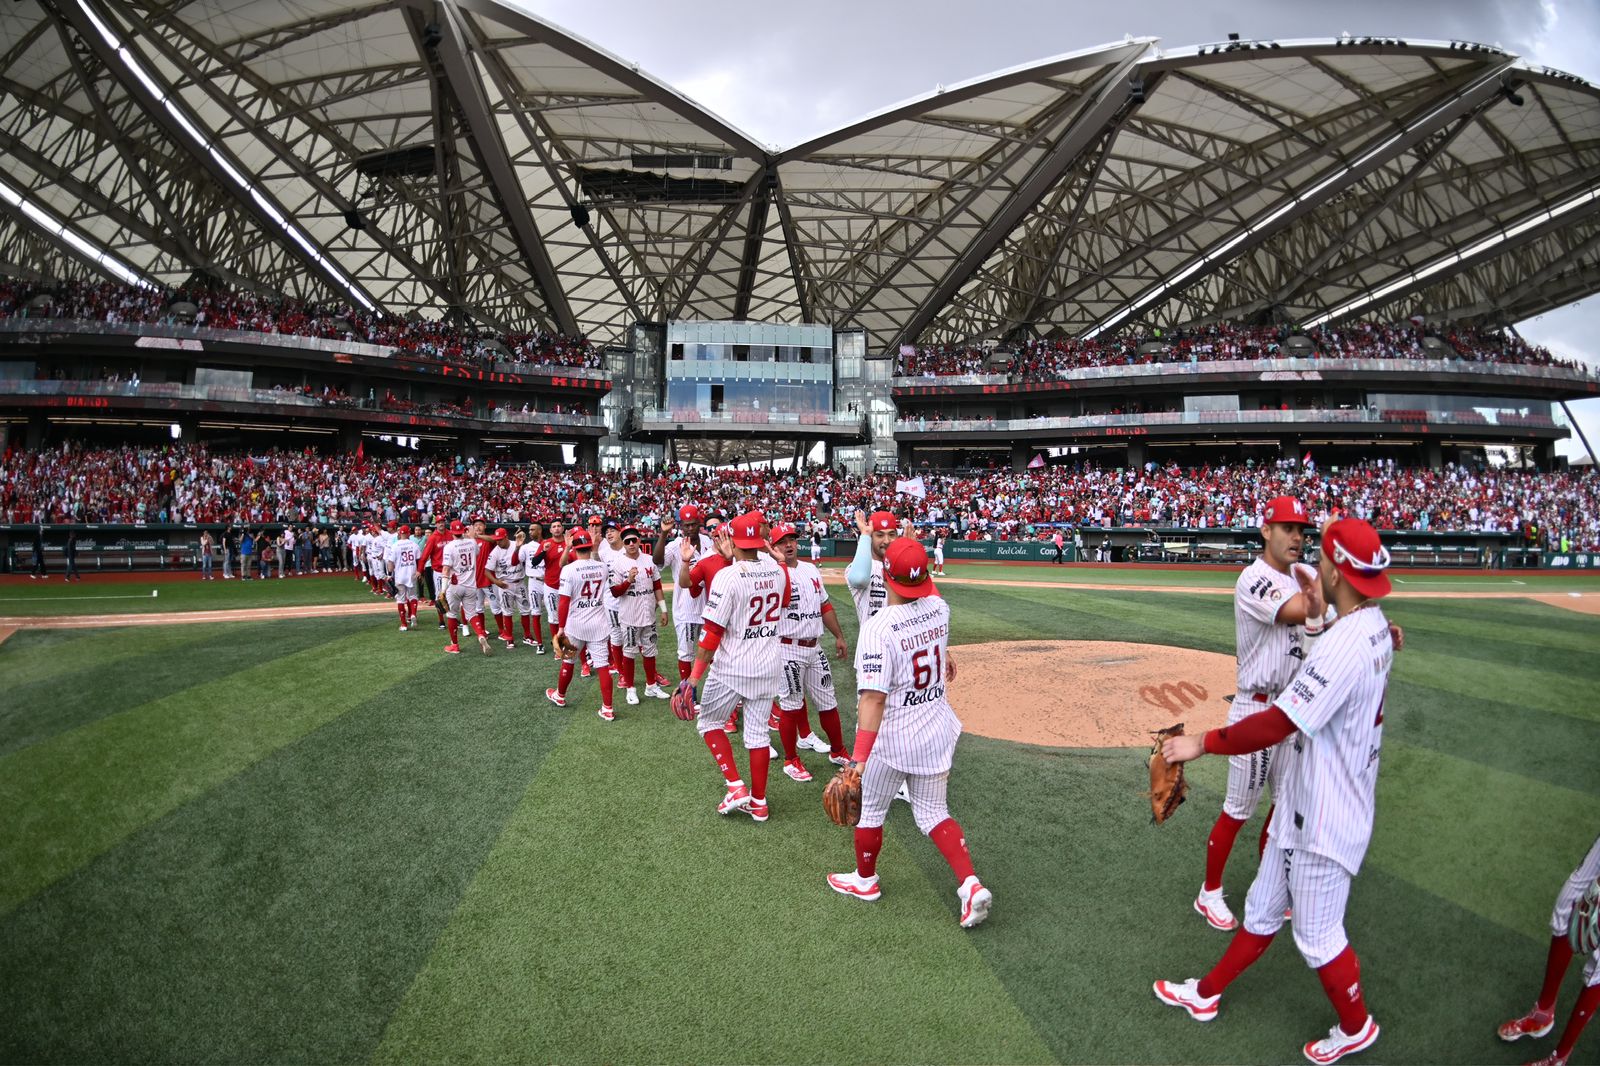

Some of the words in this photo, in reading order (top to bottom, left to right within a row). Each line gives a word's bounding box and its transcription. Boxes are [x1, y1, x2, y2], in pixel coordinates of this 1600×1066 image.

[747, 526, 754, 536] M
[401, 550, 414, 562] 36
[1040, 547, 1069, 556] Comx
[460, 553, 472, 567] 31
[910, 567, 920, 580] M
[581, 579, 602, 600] 47
[754, 579, 774, 591] CANO
[749, 592, 780, 626] 22
[901, 623, 949, 651] GUTIERREZ
[912, 644, 941, 690] 61
